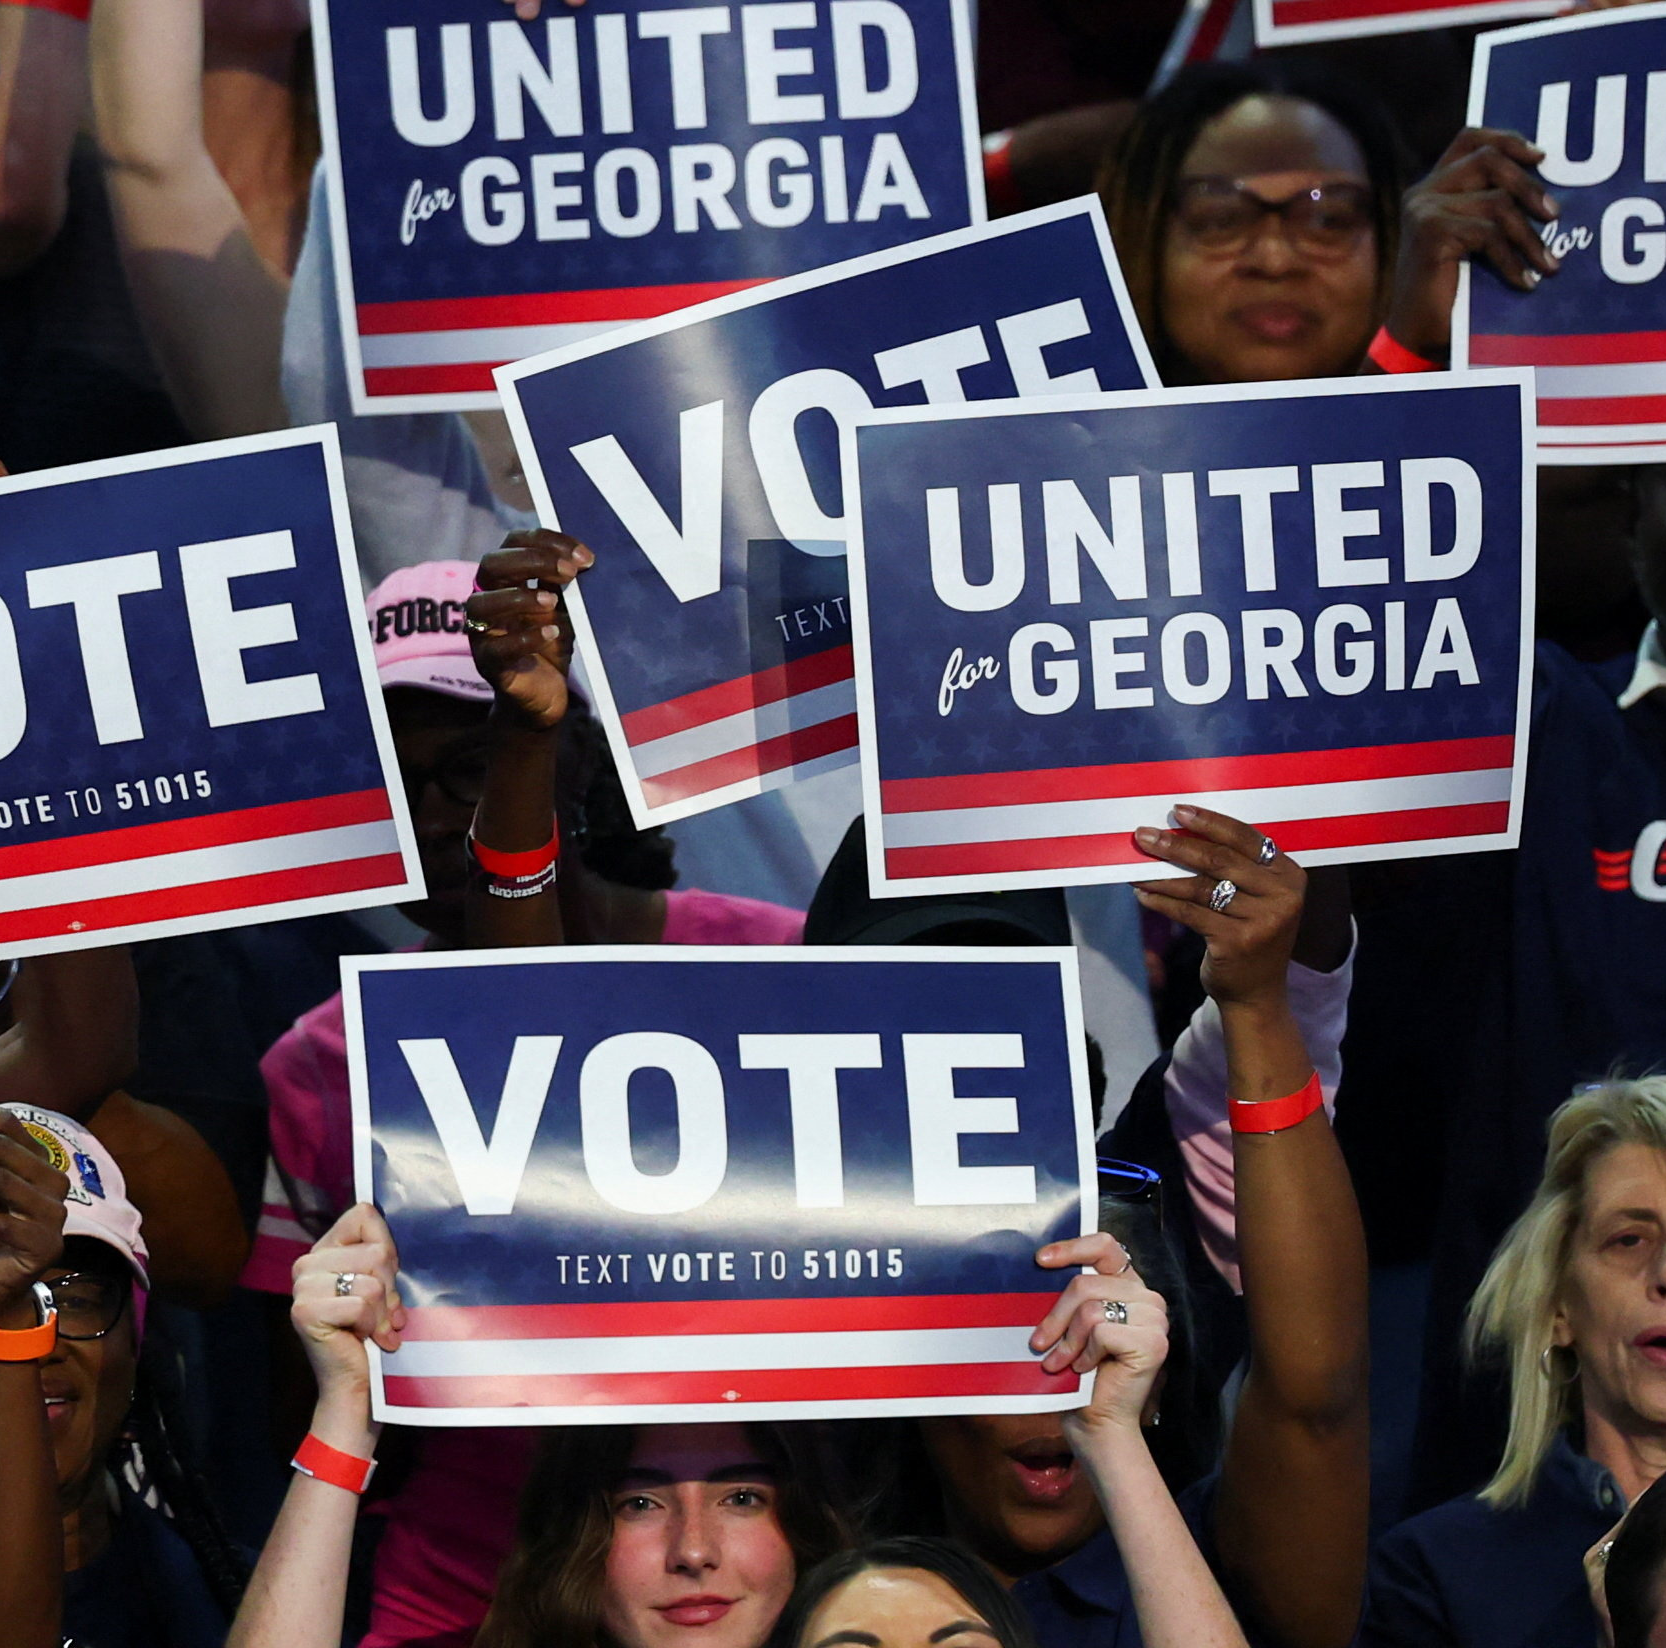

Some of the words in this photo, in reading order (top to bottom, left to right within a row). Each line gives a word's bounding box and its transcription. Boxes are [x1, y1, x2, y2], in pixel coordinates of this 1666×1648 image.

[400, 178, 456, 246] for
[459, 133, 931, 246] GEORGIA
[569, 297, 1098, 604] VOTE
[926, 456, 1483, 612] UNITED
[776, 596, 847, 642] TEXT
[938, 647, 1000, 718] for
[1009, 596, 1480, 716] GEORGIA
[67, 788, 101, 817] TO
[116, 769, 212, 810] 51015
[398, 1031, 1037, 1217] VOTE
[556, 1254, 632, 1285] TEXT
[646, 1251, 736, 1283] VOTE
[751, 1250, 787, 1280] TO
[803, 1247, 905, 1279] 51015
